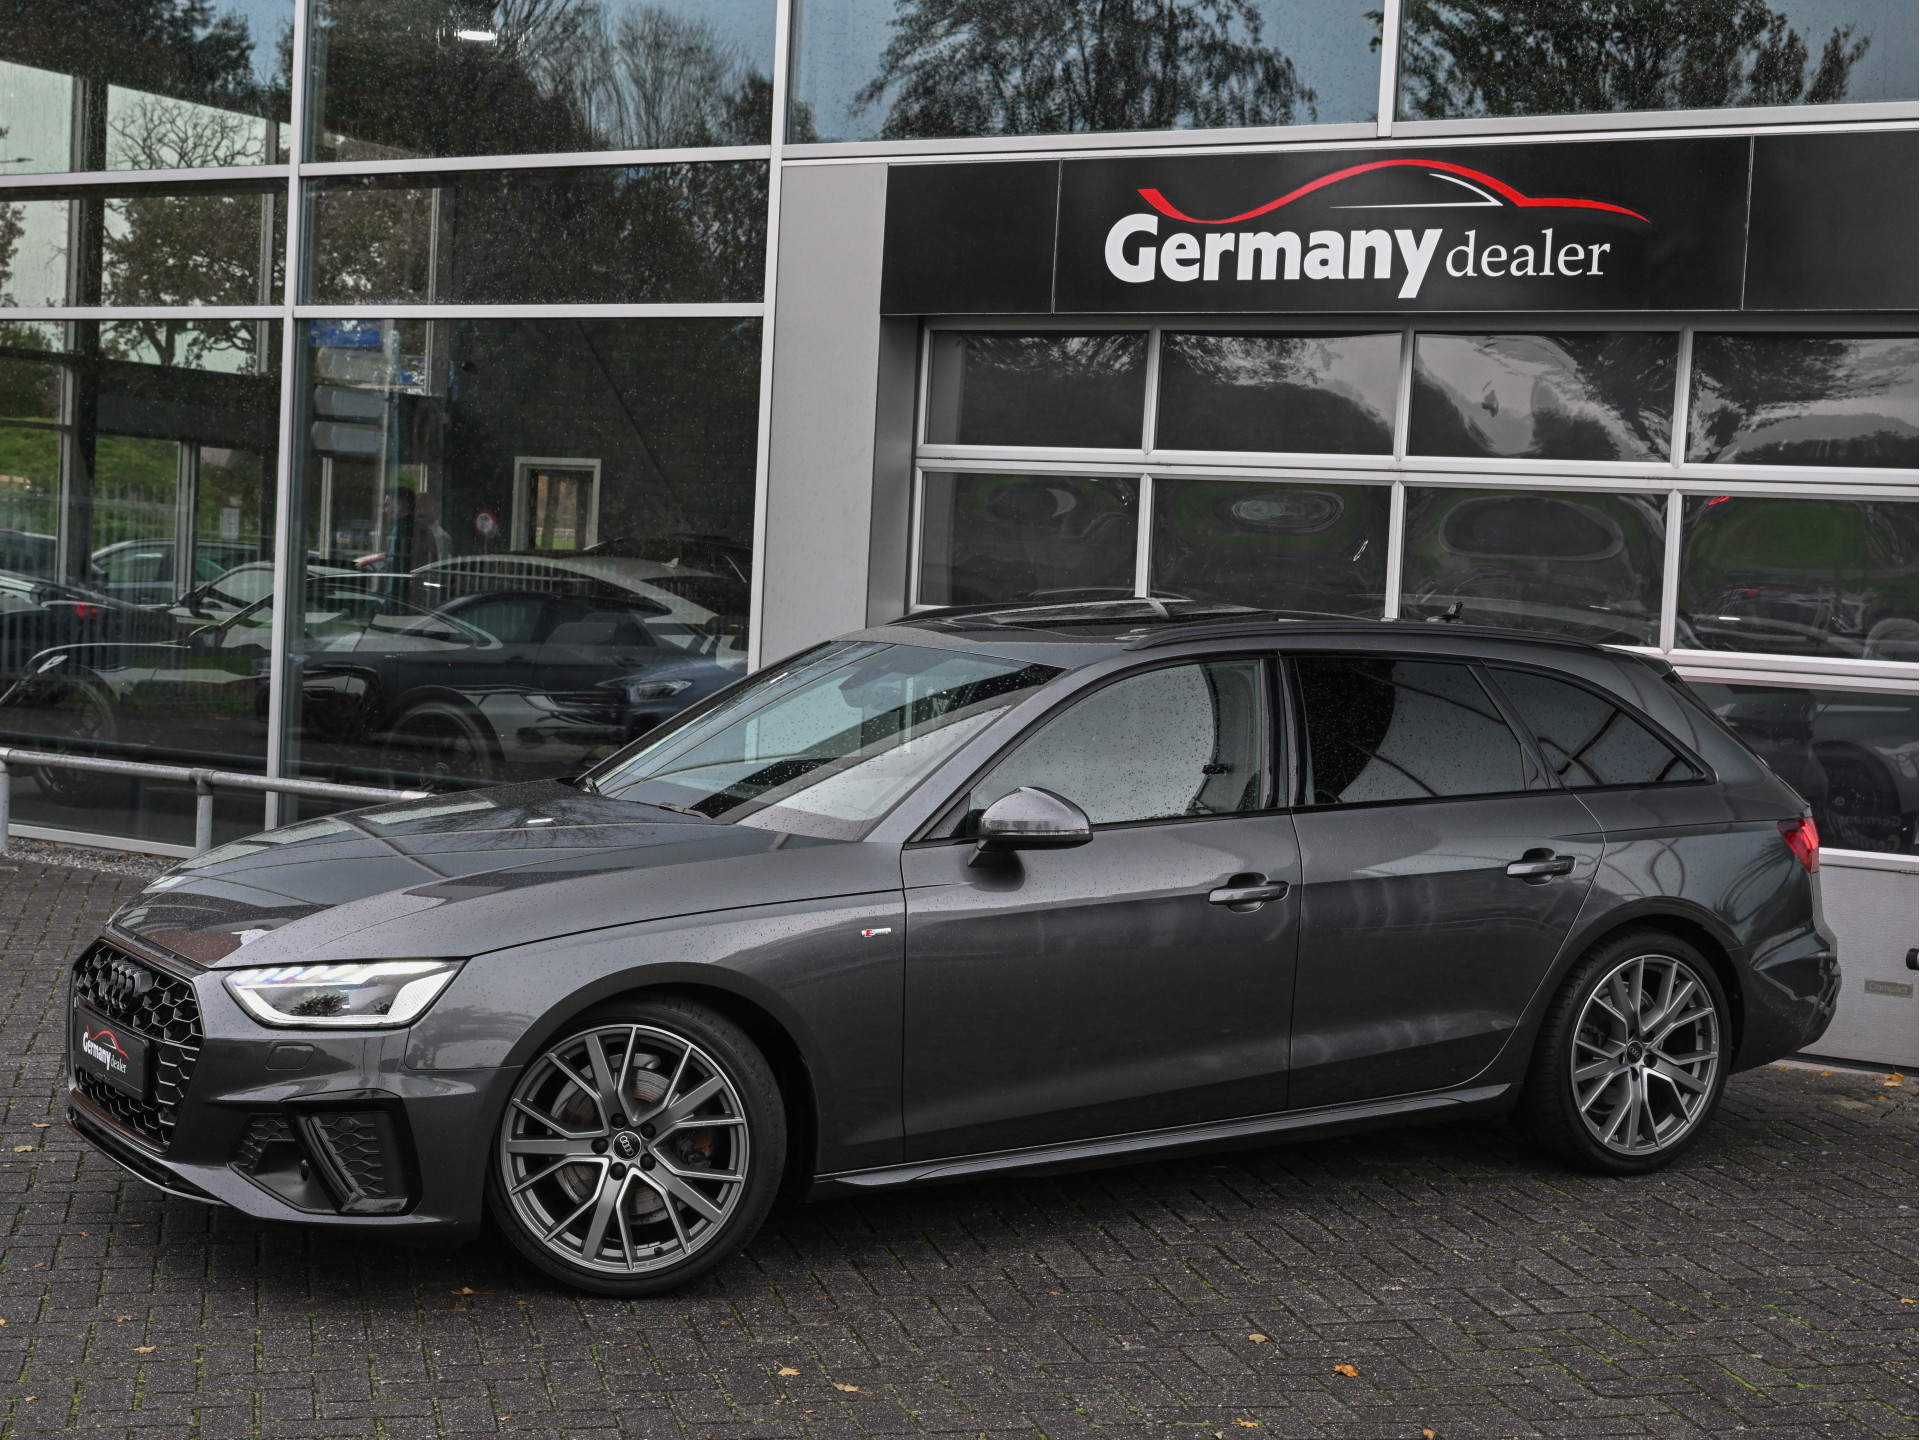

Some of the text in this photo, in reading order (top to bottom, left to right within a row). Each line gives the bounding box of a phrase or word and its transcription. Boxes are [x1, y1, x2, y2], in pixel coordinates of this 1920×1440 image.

[1104, 213, 1611, 298] Germany dealer
[1868, 982, 1908, 995] Compact
[82, 1031, 127, 1073] Germany dealer
